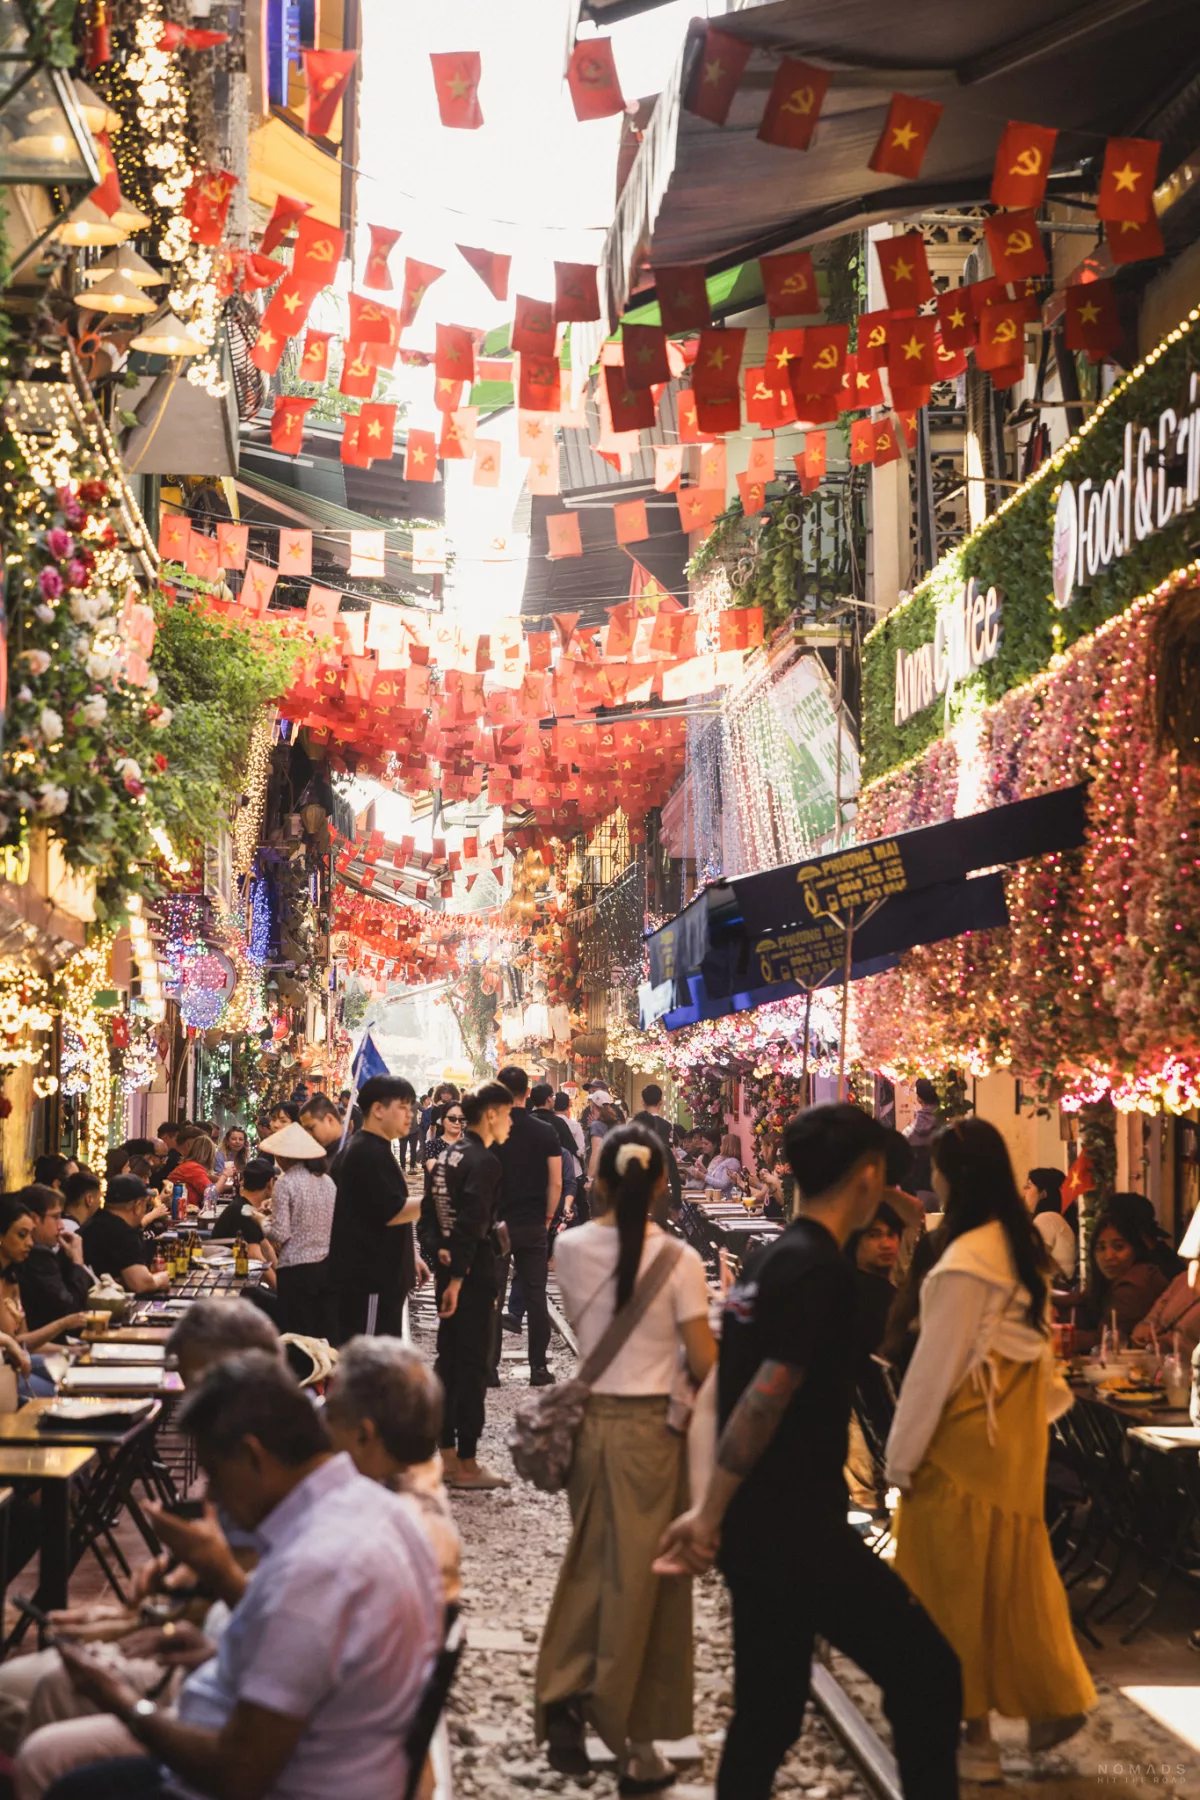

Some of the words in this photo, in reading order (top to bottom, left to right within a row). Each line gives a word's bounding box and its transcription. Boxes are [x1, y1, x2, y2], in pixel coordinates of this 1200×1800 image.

[1077, 421, 1132, 587] Food
[1134, 426, 1154, 541] &
[934, 576, 999, 694] Cffee
[792, 687, 837, 742] COFFEE
[873, 840, 900, 862] MAI
[824, 925, 845, 939] MA
